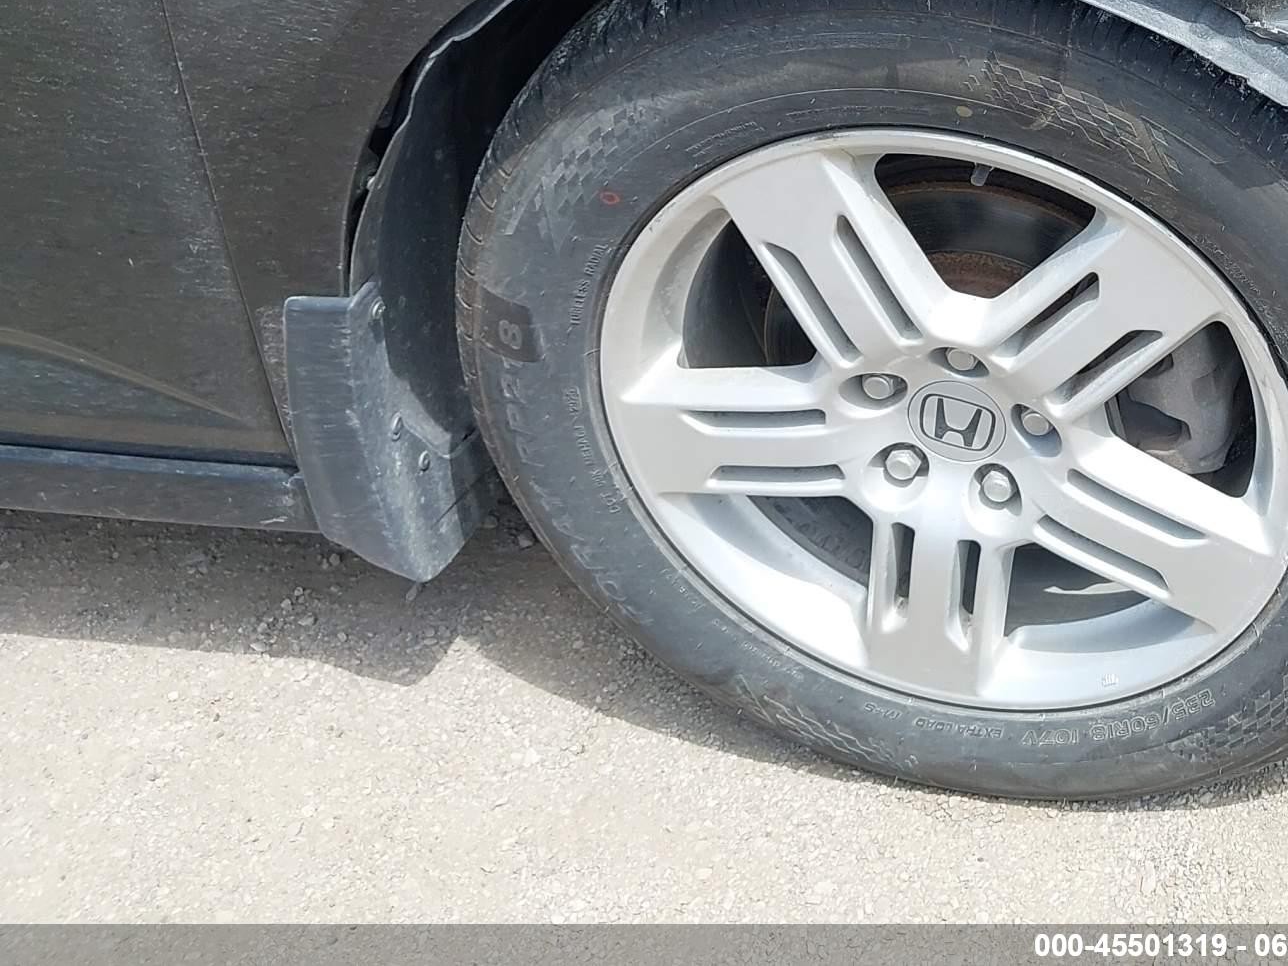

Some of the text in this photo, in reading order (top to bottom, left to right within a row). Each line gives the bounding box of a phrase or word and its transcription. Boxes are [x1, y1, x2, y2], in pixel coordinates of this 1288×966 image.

[914, 716, 956, 736] LOAD
[1091, 689, 1216, 742] 235/60R18
[957, 718, 1005, 740] EXTRA
[1021, 727, 1080, 747] 107V
